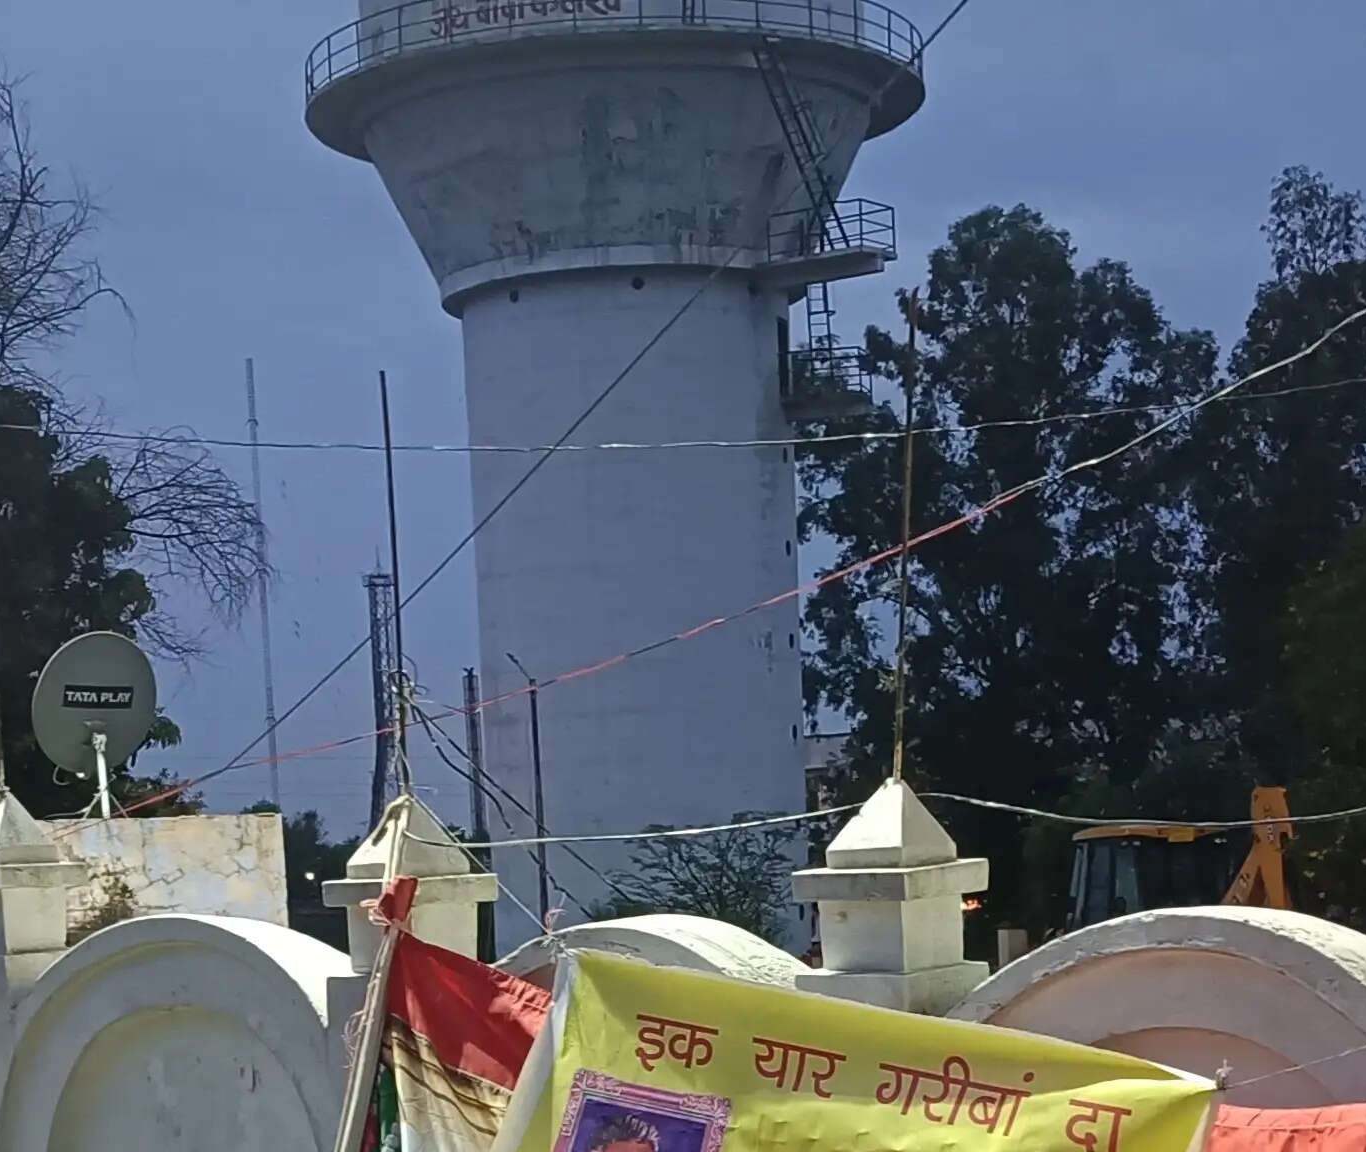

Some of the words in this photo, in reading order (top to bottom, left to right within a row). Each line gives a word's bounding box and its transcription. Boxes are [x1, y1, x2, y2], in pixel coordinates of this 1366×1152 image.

[65, 691, 98, 702] TATA
[100, 692, 132, 703] PLAY
[635, 1014, 718, 1071] इक
[753, 1036, 846, 1098] यार
[875, 1055, 1032, 1137] गरीबां
